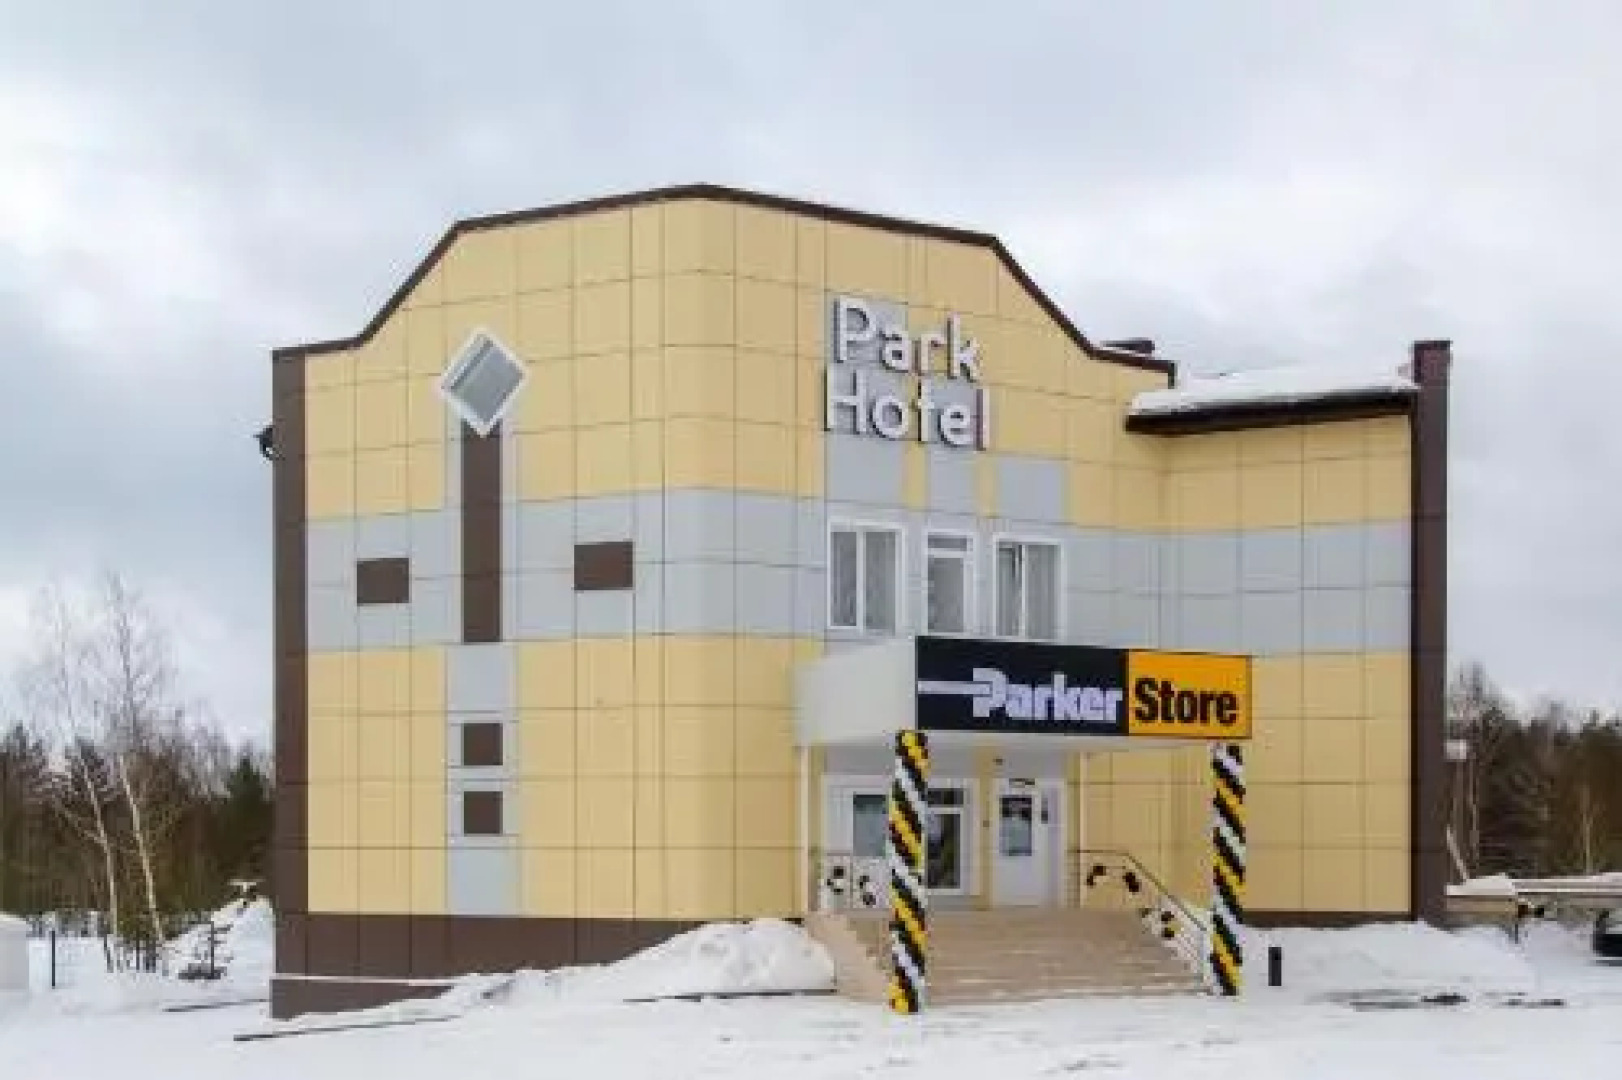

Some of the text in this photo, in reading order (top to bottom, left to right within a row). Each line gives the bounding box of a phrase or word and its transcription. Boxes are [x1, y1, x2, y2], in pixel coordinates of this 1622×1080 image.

[834, 296, 981, 383] Park
[823, 365, 991, 451] Hotel
[972, 667, 1239, 724] Parker Store
